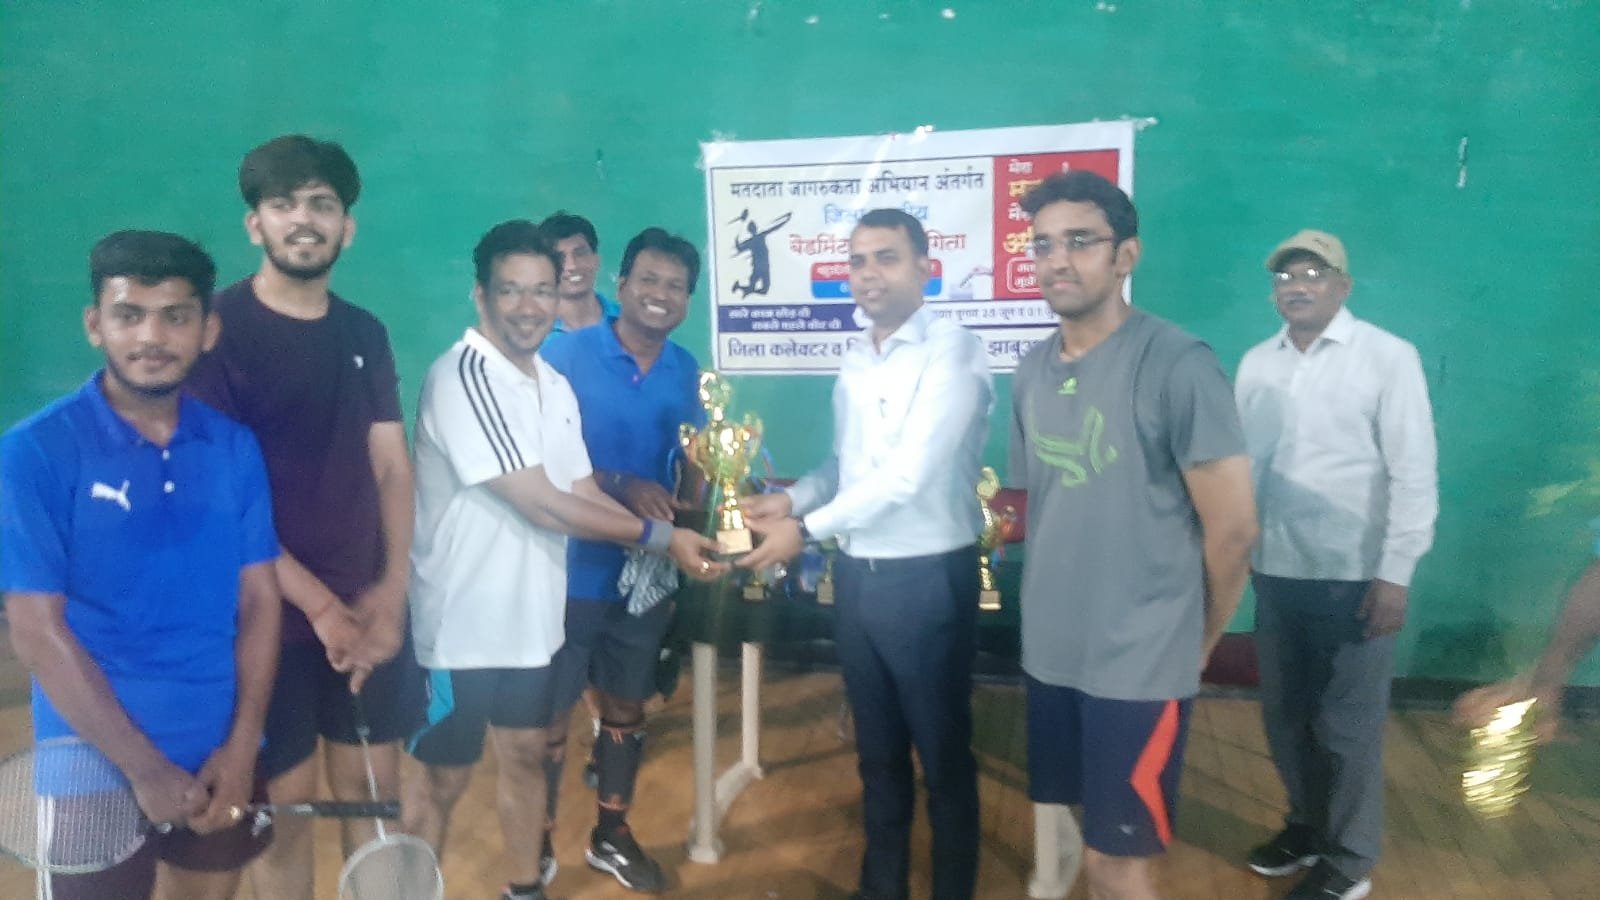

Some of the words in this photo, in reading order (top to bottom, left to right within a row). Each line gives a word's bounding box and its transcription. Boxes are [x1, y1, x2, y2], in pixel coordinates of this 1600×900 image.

[729, 182, 784, 198] मतदाता
[869, 169, 929, 193] अभियान
[728, 337, 766, 358] जिला
[831, 343, 843, 357] व
